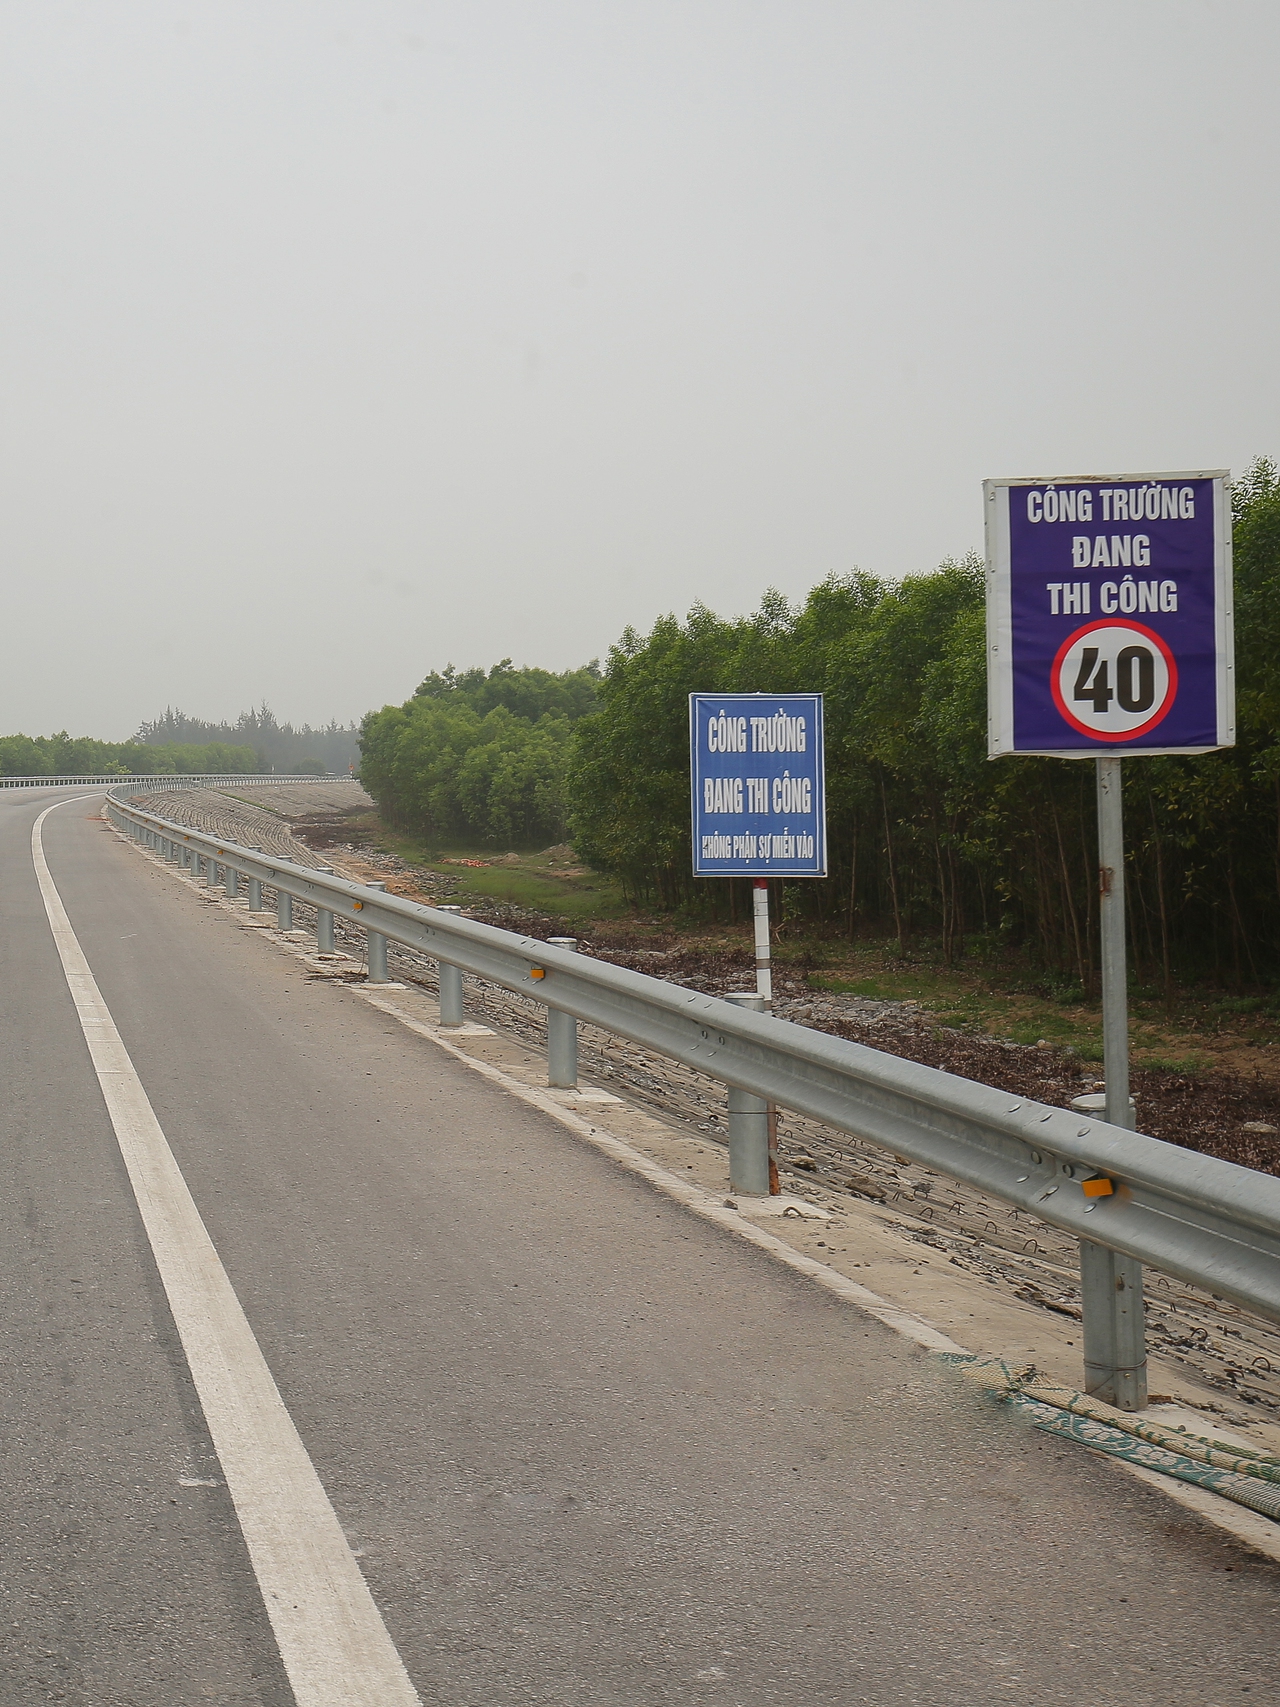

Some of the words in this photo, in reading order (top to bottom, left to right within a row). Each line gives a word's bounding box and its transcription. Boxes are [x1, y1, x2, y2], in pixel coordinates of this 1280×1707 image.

[1027, 485, 1092, 523] CÔNG
[1099, 481, 1195, 521] TRƯỜNG
[1072, 535, 1150, 568] ĐANG
[1047, 583, 1090, 615] THI
[1100, 575, 1178, 614] CÔNG
[1073, 645, 1155, 714] 40
[708, 709, 747, 753] CÔNG
[749, 708, 806, 752] TRƯỜNG
[704, 778, 743, 813] ĐANG
[746, 778, 769, 813] THI
[772, 770, 811, 814] CÔNG
[702, 830, 732, 859] KHÔNG
[733, 830, 757, 864] PHẬN
[758, 833, 771, 864] SỰ
[796, 830, 814, 859] VÀO
